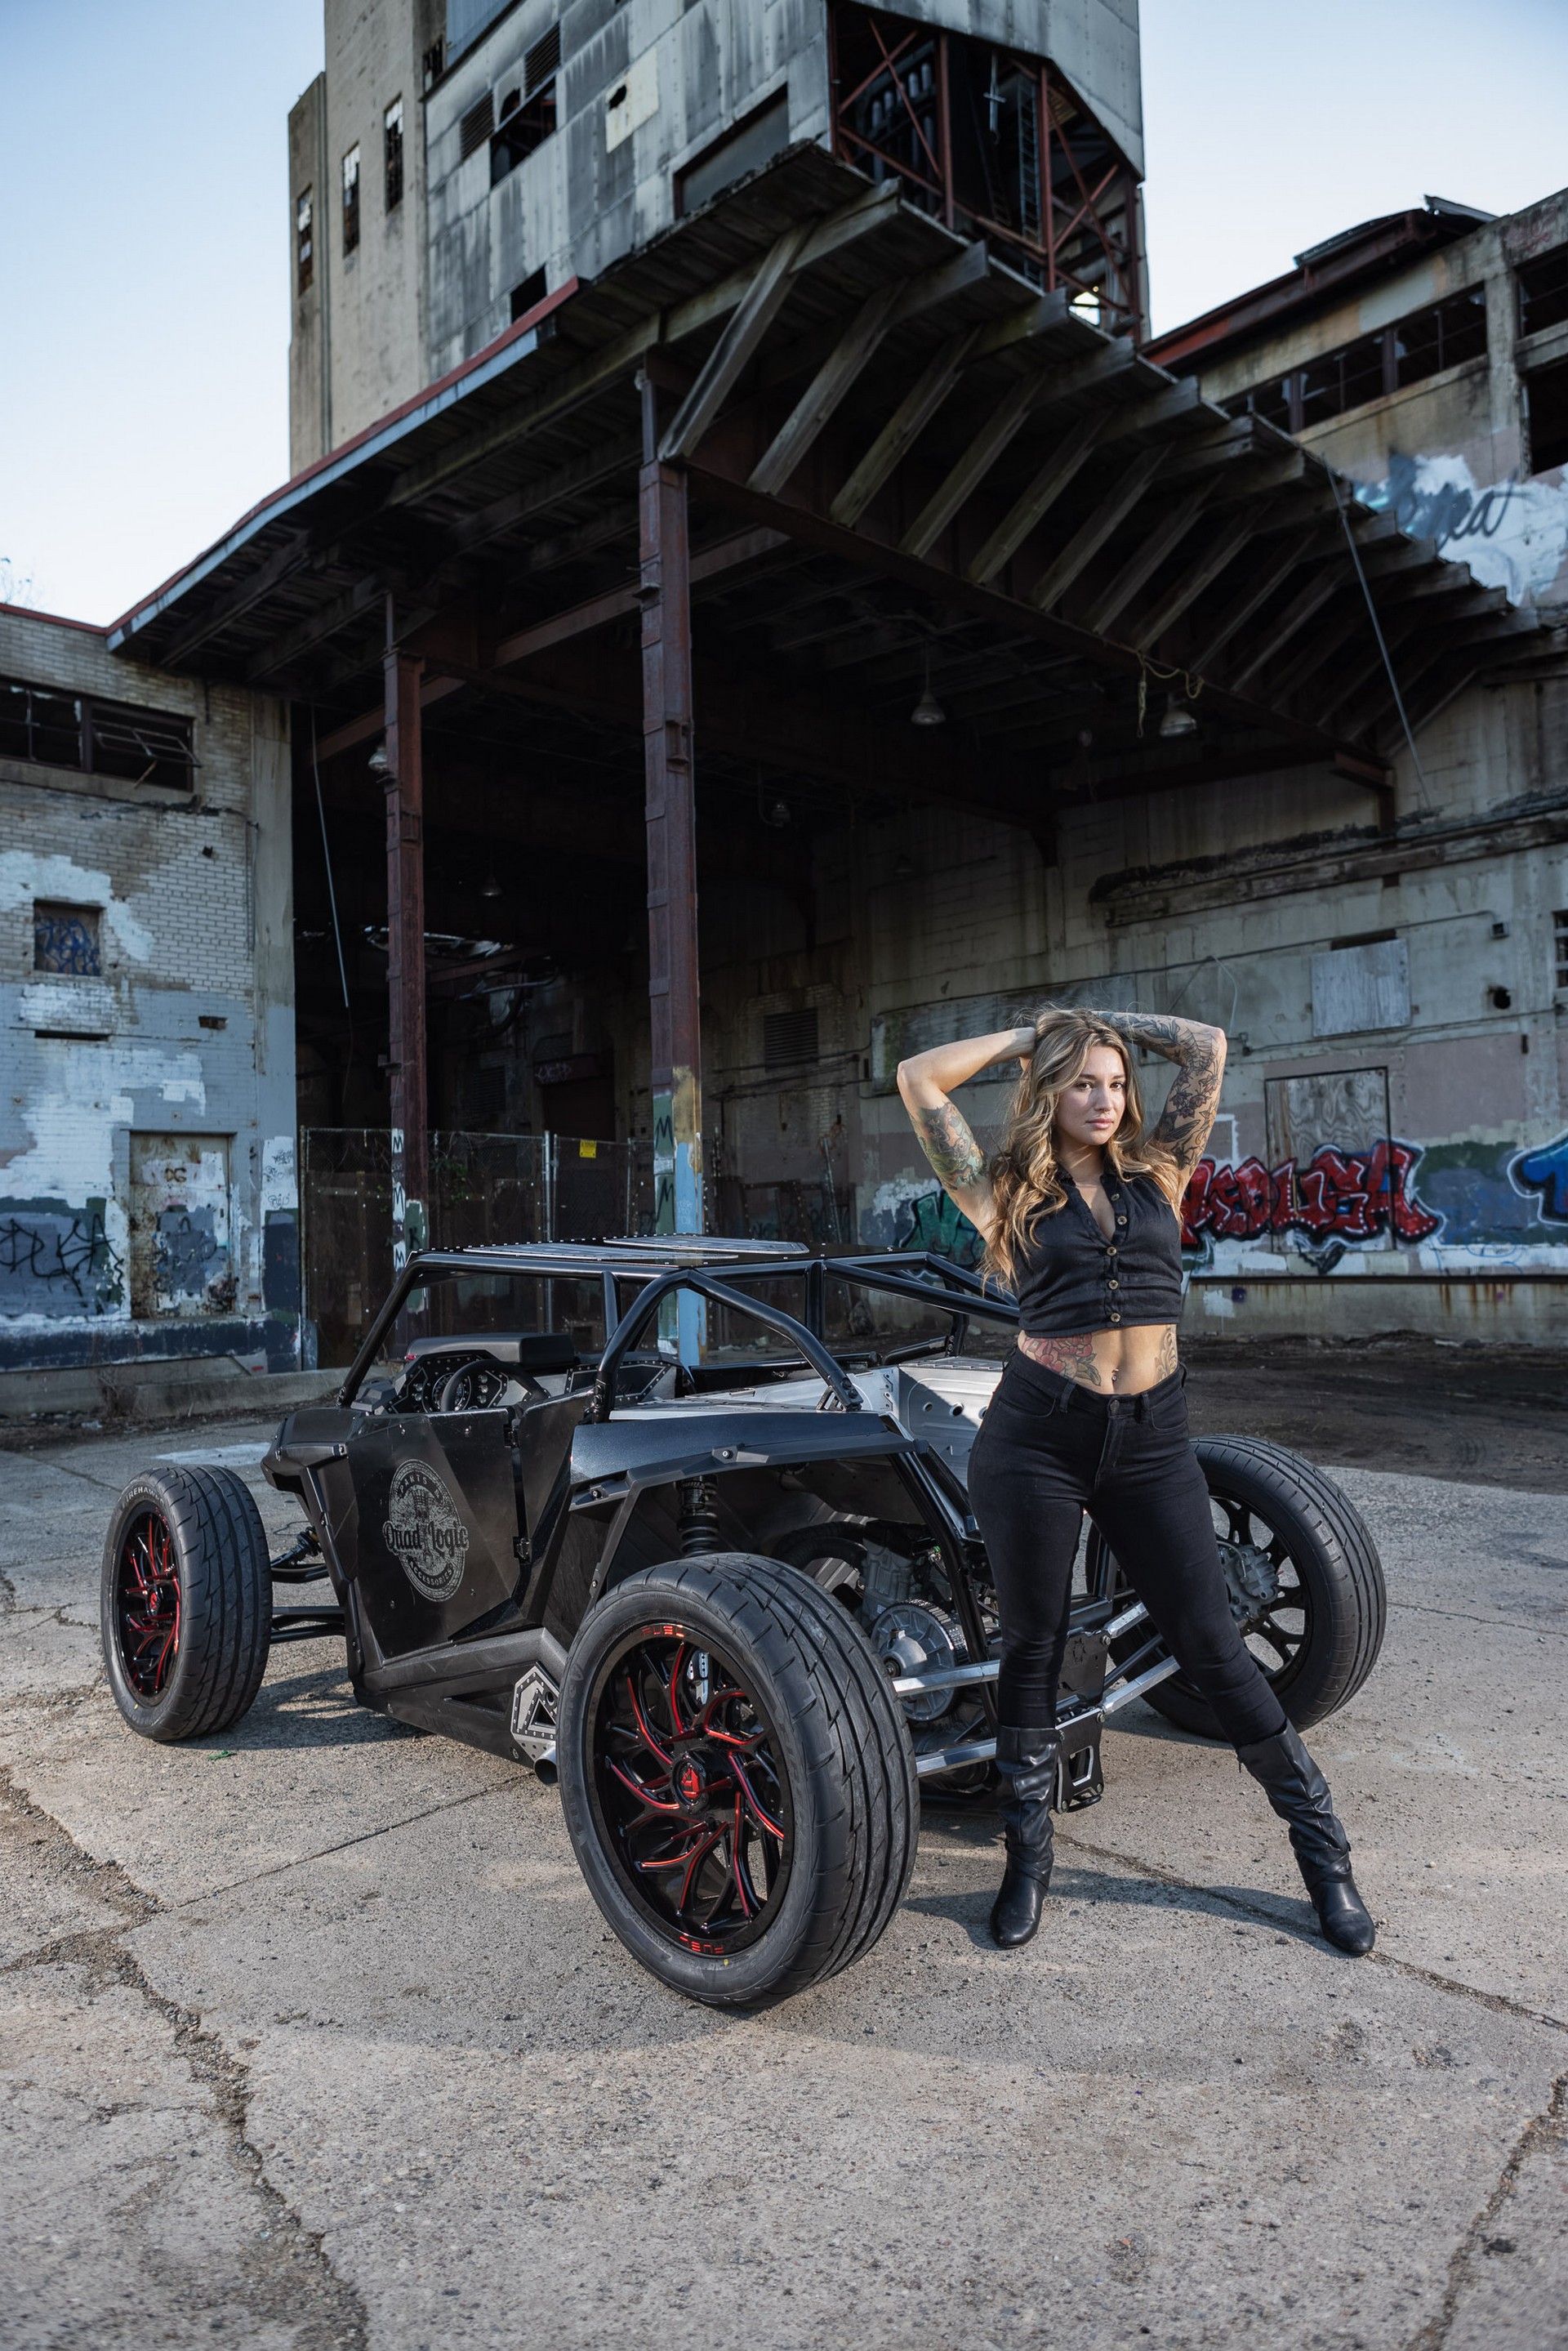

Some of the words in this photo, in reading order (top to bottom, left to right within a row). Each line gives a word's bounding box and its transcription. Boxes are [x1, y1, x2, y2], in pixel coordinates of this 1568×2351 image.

[399, 1473, 427, 1493] PARTS
[384, 1522, 423, 1552] Quad
[427, 1521, 470, 1559] Logic
[409, 1561, 453, 1586] ACCESSORIES
[642, 1625, 684, 1639] FUEL
[679, 1935, 724, 1954] FUEL
